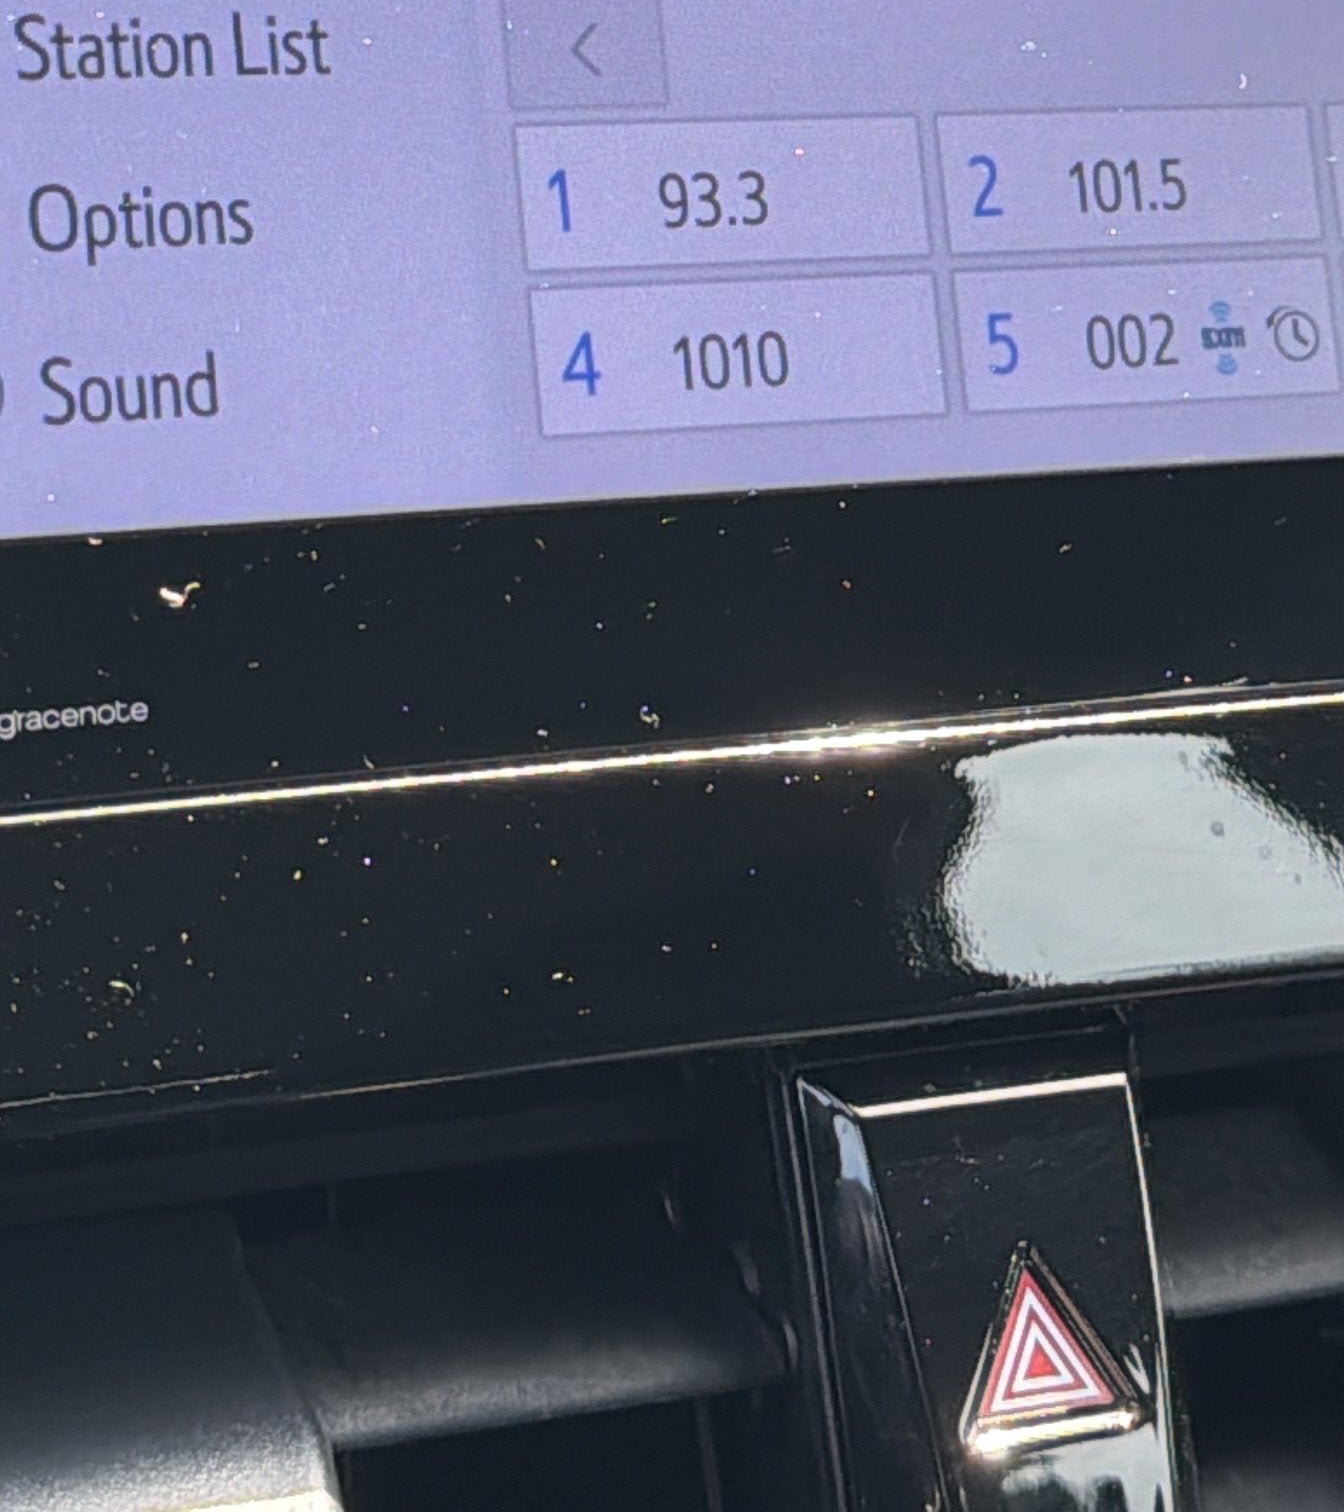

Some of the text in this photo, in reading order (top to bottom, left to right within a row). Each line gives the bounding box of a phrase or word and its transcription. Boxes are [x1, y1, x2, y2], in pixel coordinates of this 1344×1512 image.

[13, 10, 332, 82] Station List
[546, 168, 573, 233] 1
[657, 169, 770, 229] 93.3
[967, 154, 1005, 217] 2
[1068, 158, 1188, 213] 101.5
[28, 183, 255, 266] Options
[561, 331, 603, 396] 4
[672, 330, 792, 391] 1010
[986, 312, 1020, 376] 5
[1085, 313, 1180, 371] 002
[38, 350, 221, 426] Sound
